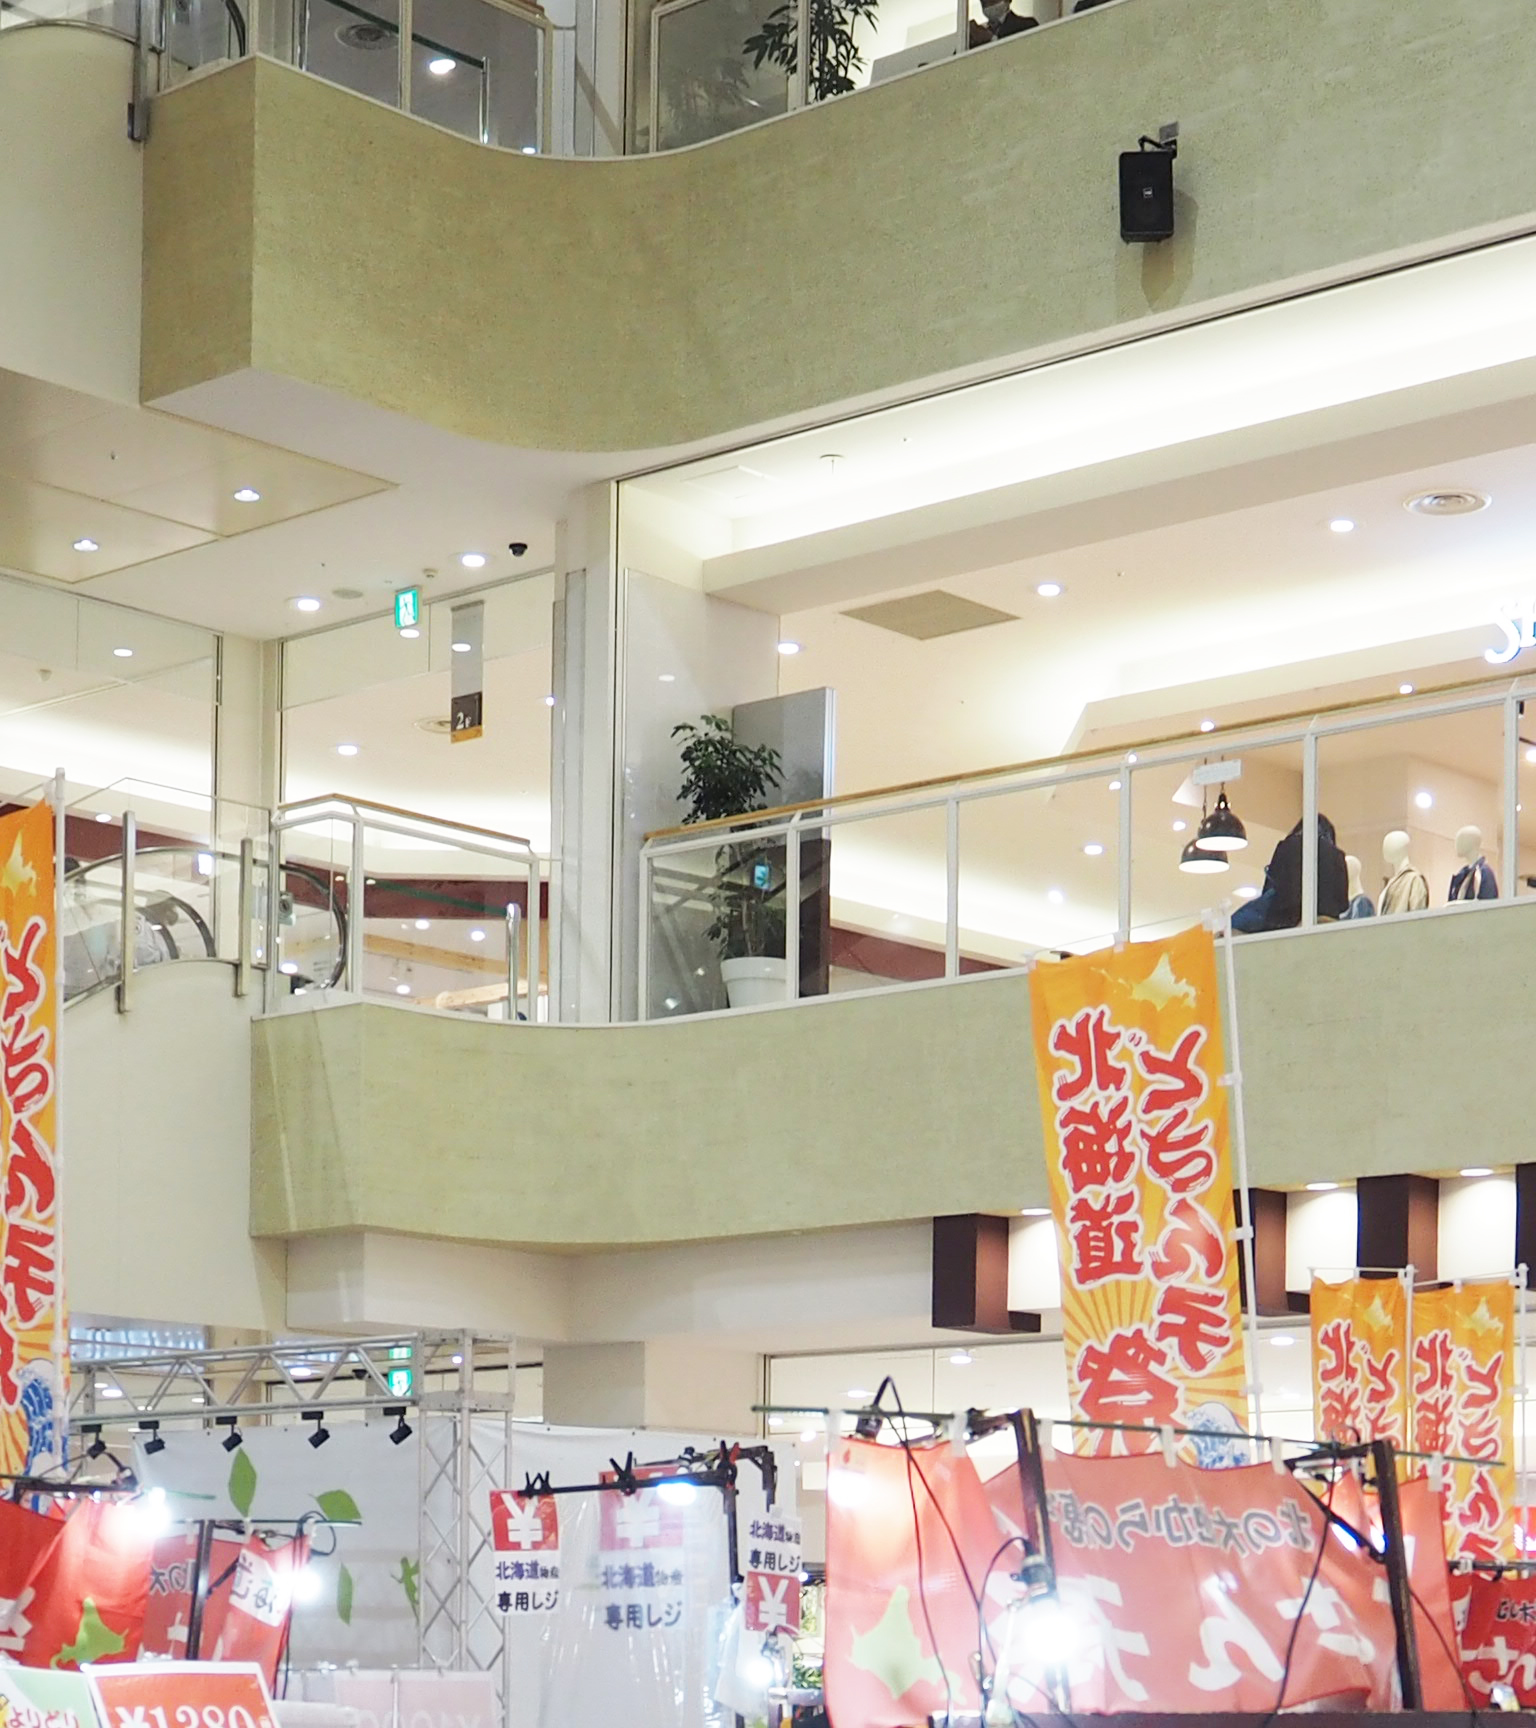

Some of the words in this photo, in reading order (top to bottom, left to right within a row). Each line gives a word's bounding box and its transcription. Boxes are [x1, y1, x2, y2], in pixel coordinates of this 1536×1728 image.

[1049, 1006, 1147, 1289] 北海道
[749, 1549, 801, 1574] 専用レジ
[497, 1590, 560, 1613] 専用レジ
[606, 1603, 682, 1631] 専用レジ
